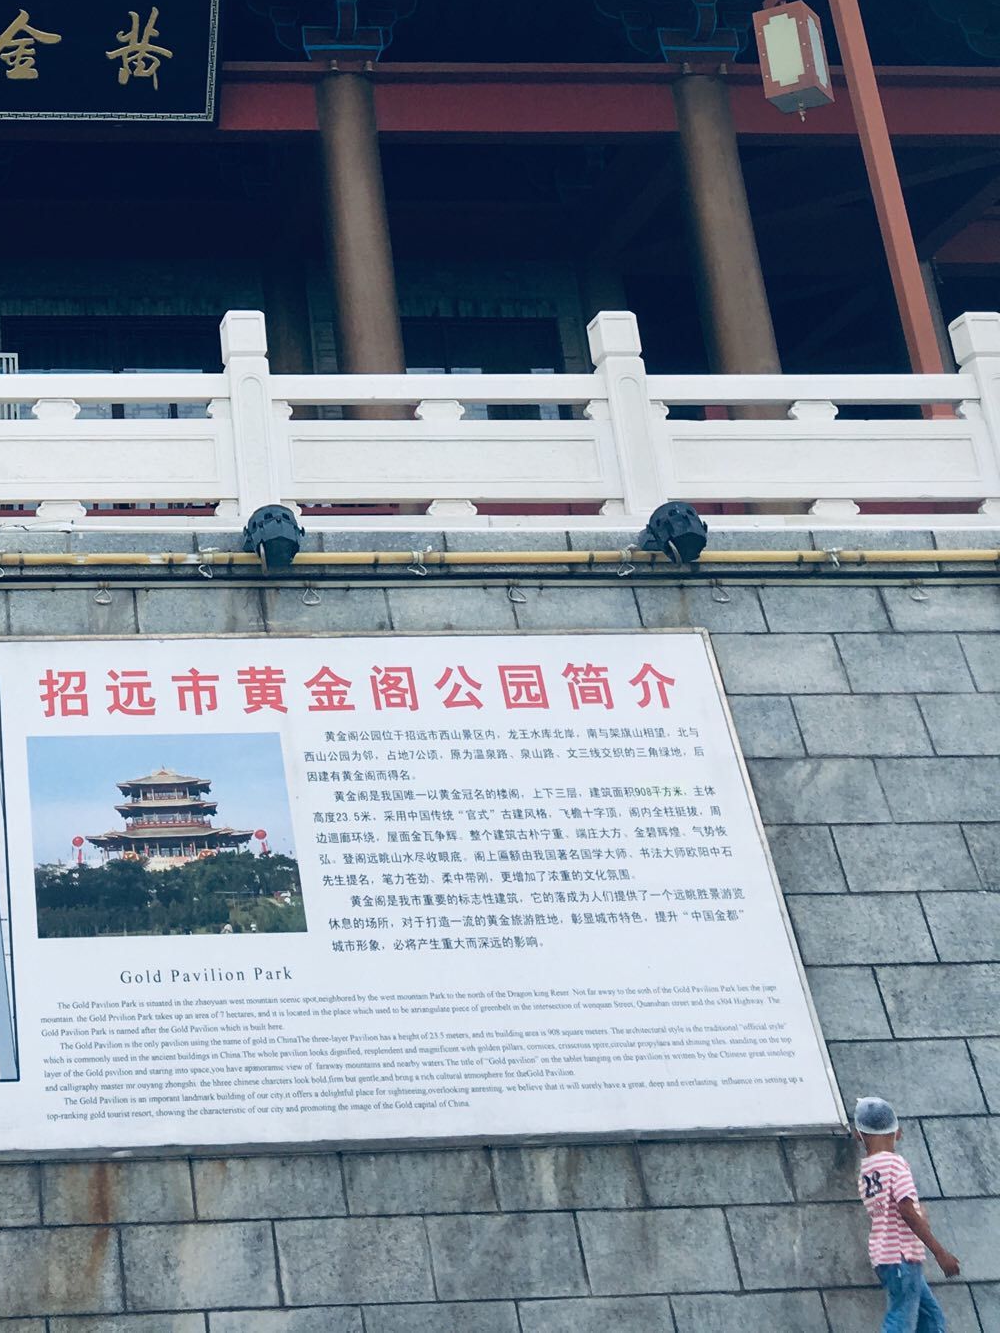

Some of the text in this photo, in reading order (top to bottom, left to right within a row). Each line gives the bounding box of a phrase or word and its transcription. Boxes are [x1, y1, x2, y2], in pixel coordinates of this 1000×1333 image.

[39, 662, 675, 717] 招远市黄金阁公园简介
[307, 769, 416, 783] 因建有黄金阁而得名。
[119, 966, 293, 984] Gold Pavilion Park
[57, 1001, 70, 1009] The
[72, 1001, 89, 1009] Gold
[91, 1000, 119, 1008] Pavilion
[121, 999, 136, 1007] Park
[182, 998, 192, 1006] the
[367, 993, 377, 1001] the
[430, 991, 444, 999] Park
[467, 990, 484, 998] north
[507, 990, 532, 998] Dragon
[77, 1014, 87, 1022] the
[89, 1013, 106, 1022] Gold
[137, 1012, 152, 1020] Park
[155, 1012, 172, 1020] takes
[257, 1009, 270, 1017] and
[286, 1008, 310, 1016] located
[321, 1007, 331, 1015] the
[333, 1007, 350, 1016] place
[352, 1006, 373, 1014] which
[375, 1006, 390, 1014] used
[451, 1005, 469, 1013] piece
[480, 1003, 510, 1013] greenbelt
[41, 1028, 58, 1036] Gold
[60, 1028, 89, 1036] Pavilion
[91, 1027, 105, 1035] Park
[116, 1026, 139, 1034] named
[141, 1026, 156, 1034] after
[170, 1025, 188, 1033] Gold
[190, 1024, 218, 1032] Pavilion
[220, 1023, 240, 1031] which
[250, 1022, 265, 1030] built
[75, 1041, 92, 1049] Gold
[94, 1040, 122, 1049] Pavilion
[144, 1039, 158, 1048] only
[160, 1039, 188, 1049] pavilion
[252, 1036, 267, 1045] gold
[350, 1033, 377, 1041] Pavilion
[495, 1029, 523, 1038] building
[43, 1055, 64, 1064] which
[74, 1054, 109, 1064] commonly
[113, 1053, 128, 1062] used
[138, 1053, 149, 1061] the
[178, 1052, 209, 1061] buildings
[257, 1049, 277, 1057] whole
[280, 1049, 307, 1058] pavilion
[309, 1048, 327, 1056] looks
[404, 1045, 417, 1053] and
[477, 1043, 500, 1053] golden
[44, 1070, 61, 1079] layer
[72, 1069, 83, 1077] the
[85, 1068, 103, 1076] Gold
[135, 1067, 147, 1075] and
[226, 1064, 241, 1072] have
[397, 1059, 419, 1068] nearby
[45, 1083, 57, 1091] and
[59, 1082, 98, 1092] calligraphy
[200, 1079, 210, 1087] the
[233, 1078, 259, 1086] chinese
[294, 1075, 308, 1084] look
[395, 1073, 413, 1082] bring
[420, 1072, 434, 1080] rich
[436, 1071, 462, 1080] cultural
[464, 1071, 502, 1080] atmosphere
[64, 1097, 77, 1105] The
[79, 1096, 97, 1104] Gold
[99, 1095, 128, 1104] Pavilion
[181, 1093, 214, 1101] landmark
[216, 1092, 245, 1101] building
[292, 1089, 312, 1098] offers
[320, 1088, 353, 1098] delightful
[355, 1088, 373, 1097] place
[517, 1083, 542, 1091] believe
[544, 1082, 557, 1090] that
[566, 1081, 579, 1089] will
[581, 1081, 601, 1089] surely
[47, 1111, 87, 1121] top-ranking
[89, 1110, 105, 1120] gold
[155, 1108, 185, 1117] showing
[187, 1107, 198, 1115] the
[200, 1106, 245, 1115] characteristic
[270, 1106, 283, 1114] city
[285, 1104, 298, 1112] and
[300, 1104, 335, 1113] promoting
[338, 1102, 348, 1110] the
[350, 1103, 371, 1112] image
[382, 1101, 392, 1109] the
[395, 1100, 412, 1108] Gold
[414, 1099, 436, 1110] capital
